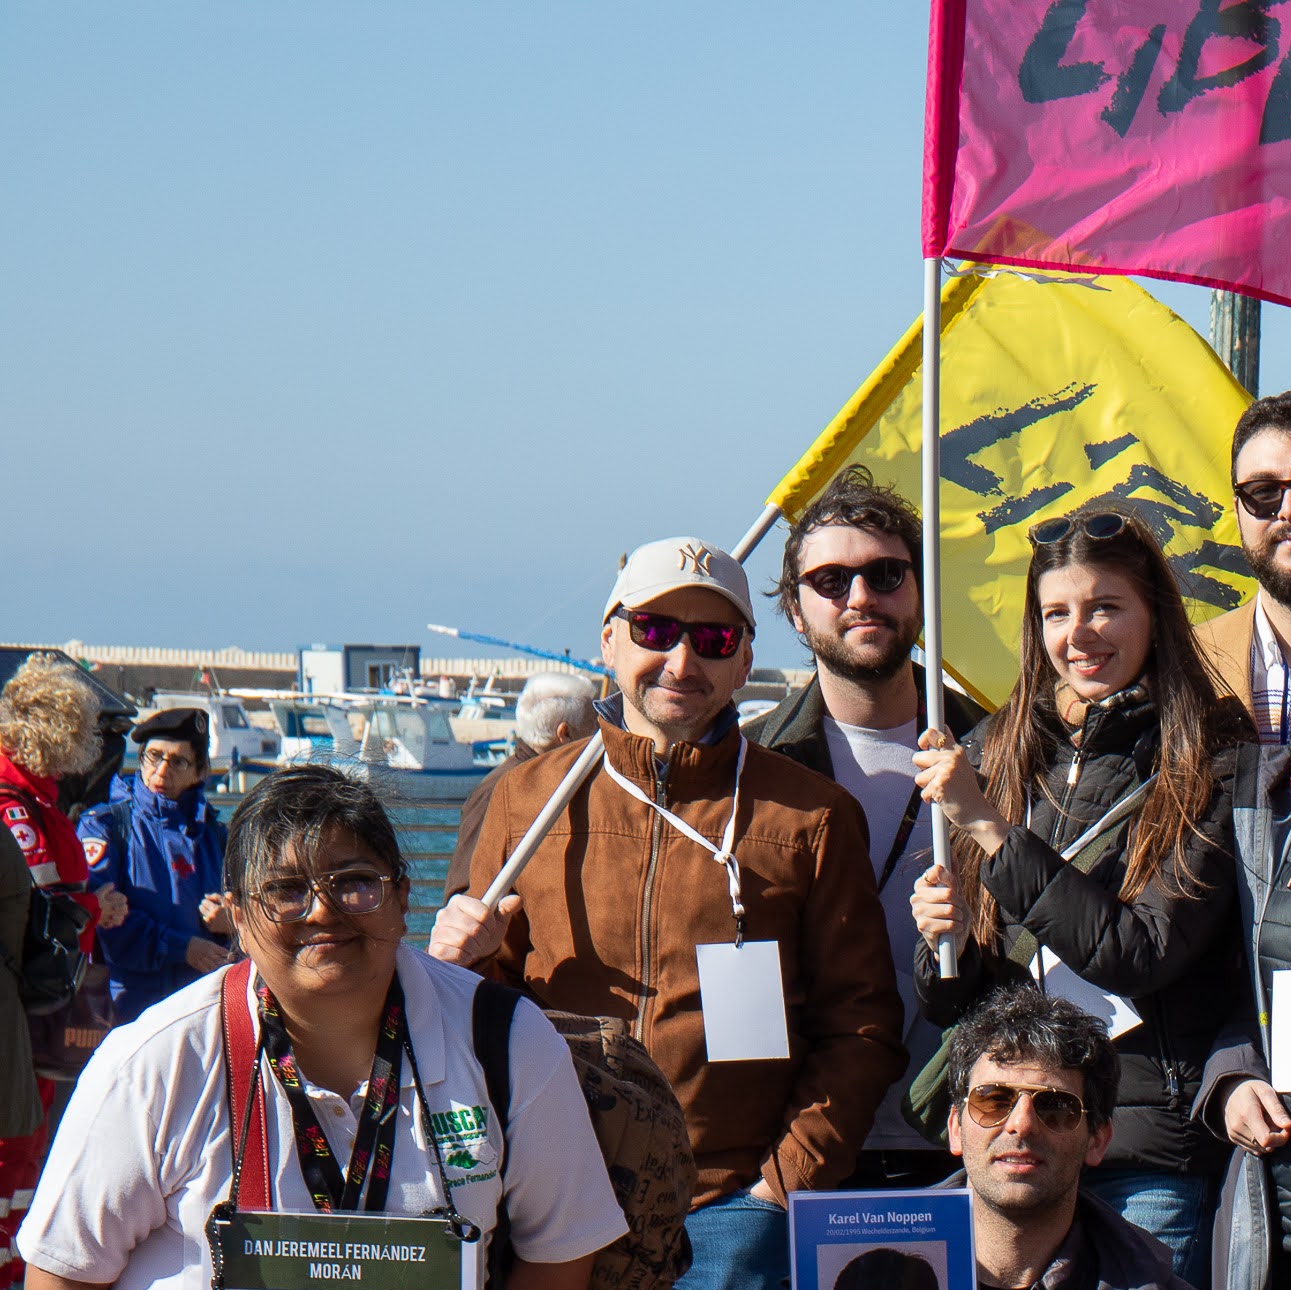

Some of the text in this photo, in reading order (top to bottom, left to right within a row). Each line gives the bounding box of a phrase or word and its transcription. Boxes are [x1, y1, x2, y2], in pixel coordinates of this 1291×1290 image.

[64, 1028, 101, 1048] PUM
[828, 1211, 932, 1225] Karel Van Noppen
[911, 1226, 936, 1235] Belgium
[244, 1239, 426, 1262] DAN JEREMEEL FERNÁNDEZ
[310, 1262, 361, 1280] MORÁN
